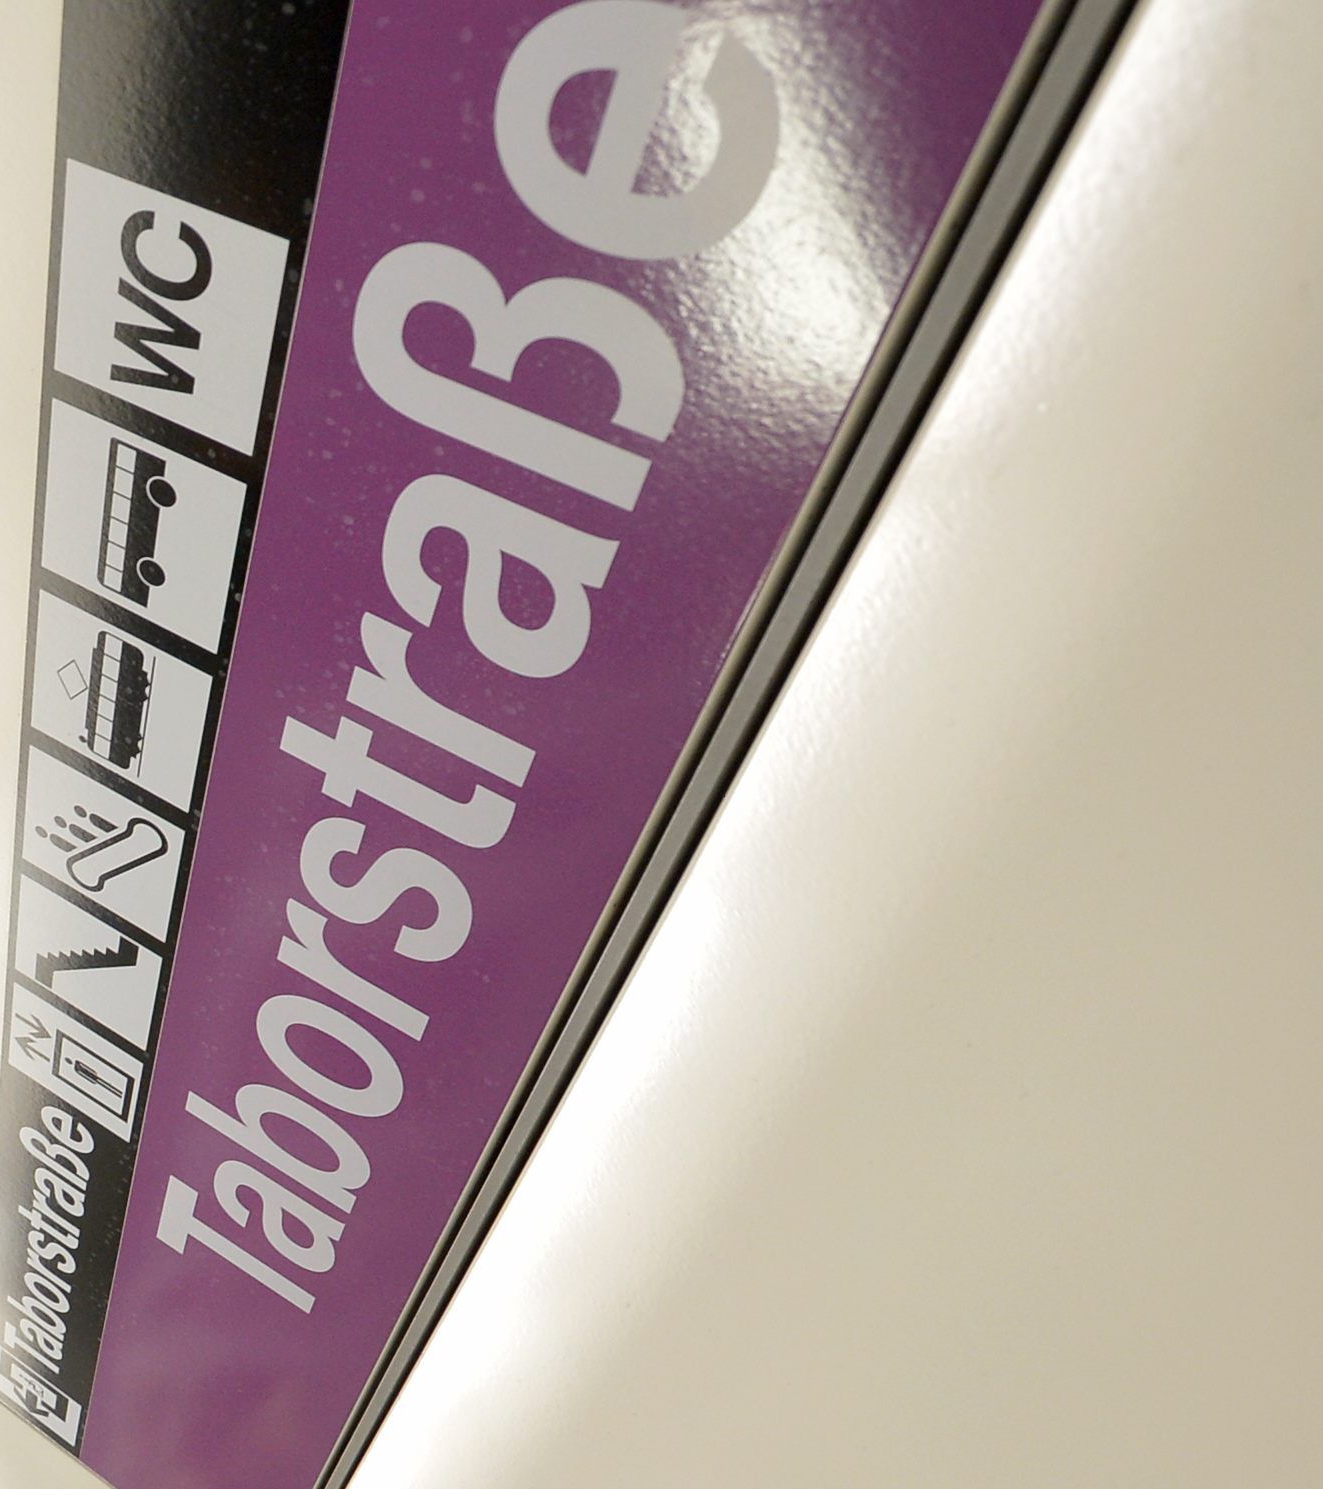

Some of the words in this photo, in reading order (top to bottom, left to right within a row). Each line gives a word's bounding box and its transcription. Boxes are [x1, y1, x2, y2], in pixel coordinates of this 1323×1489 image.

[110, 209, 213, 394] WC
[156, 0, 782, 1315] Taborstraße
[4, 1105, 95, 1375] Taborstraße
